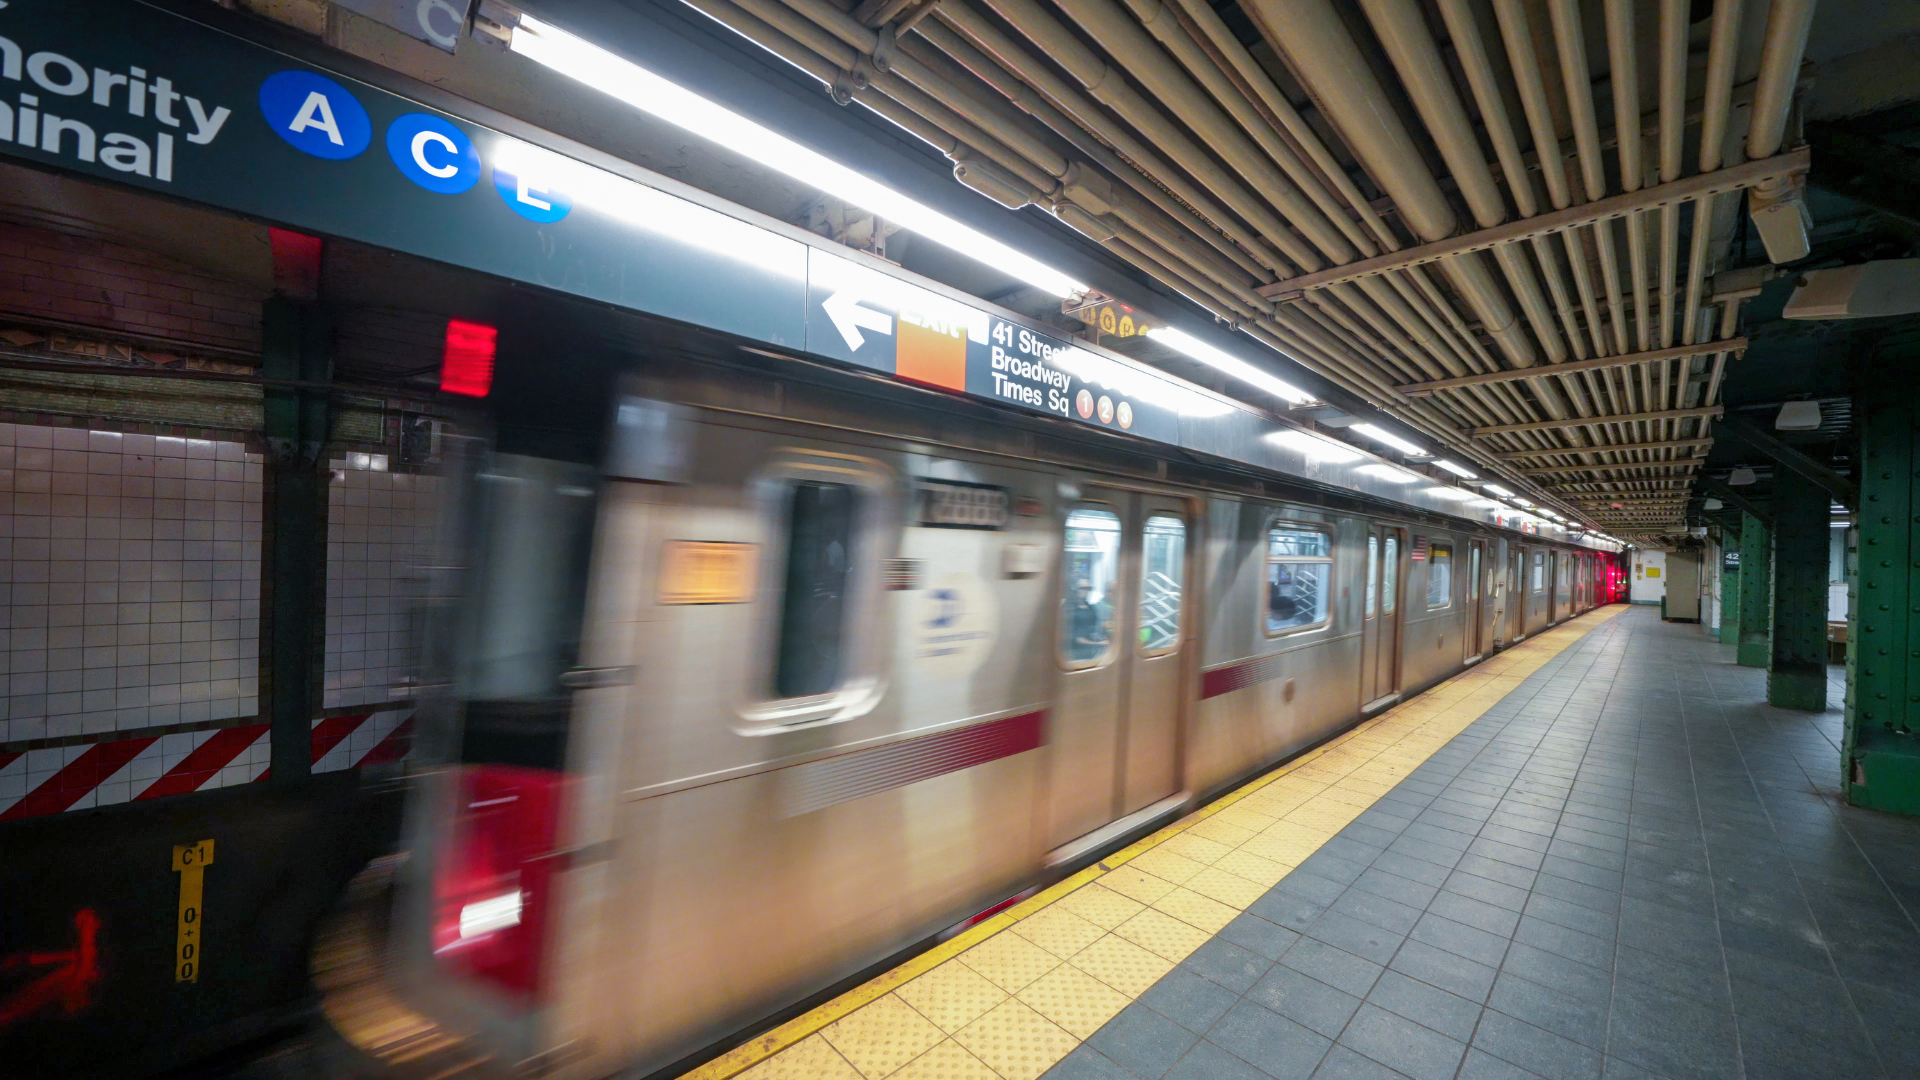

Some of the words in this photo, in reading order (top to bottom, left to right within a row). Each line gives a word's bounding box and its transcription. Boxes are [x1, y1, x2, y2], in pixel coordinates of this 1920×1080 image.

[289, 91, 344, 146] A
[411, 130, 458, 178] C
[516, 163, 551, 211] E
[993, 321, 1013, 348] 41
[992, 345, 1071, 394] Broadway
[992, 371, 1043, 406] Times
[1048, 388, 1069, 417] Sq
[1725, 552, 1740, 560] 42
